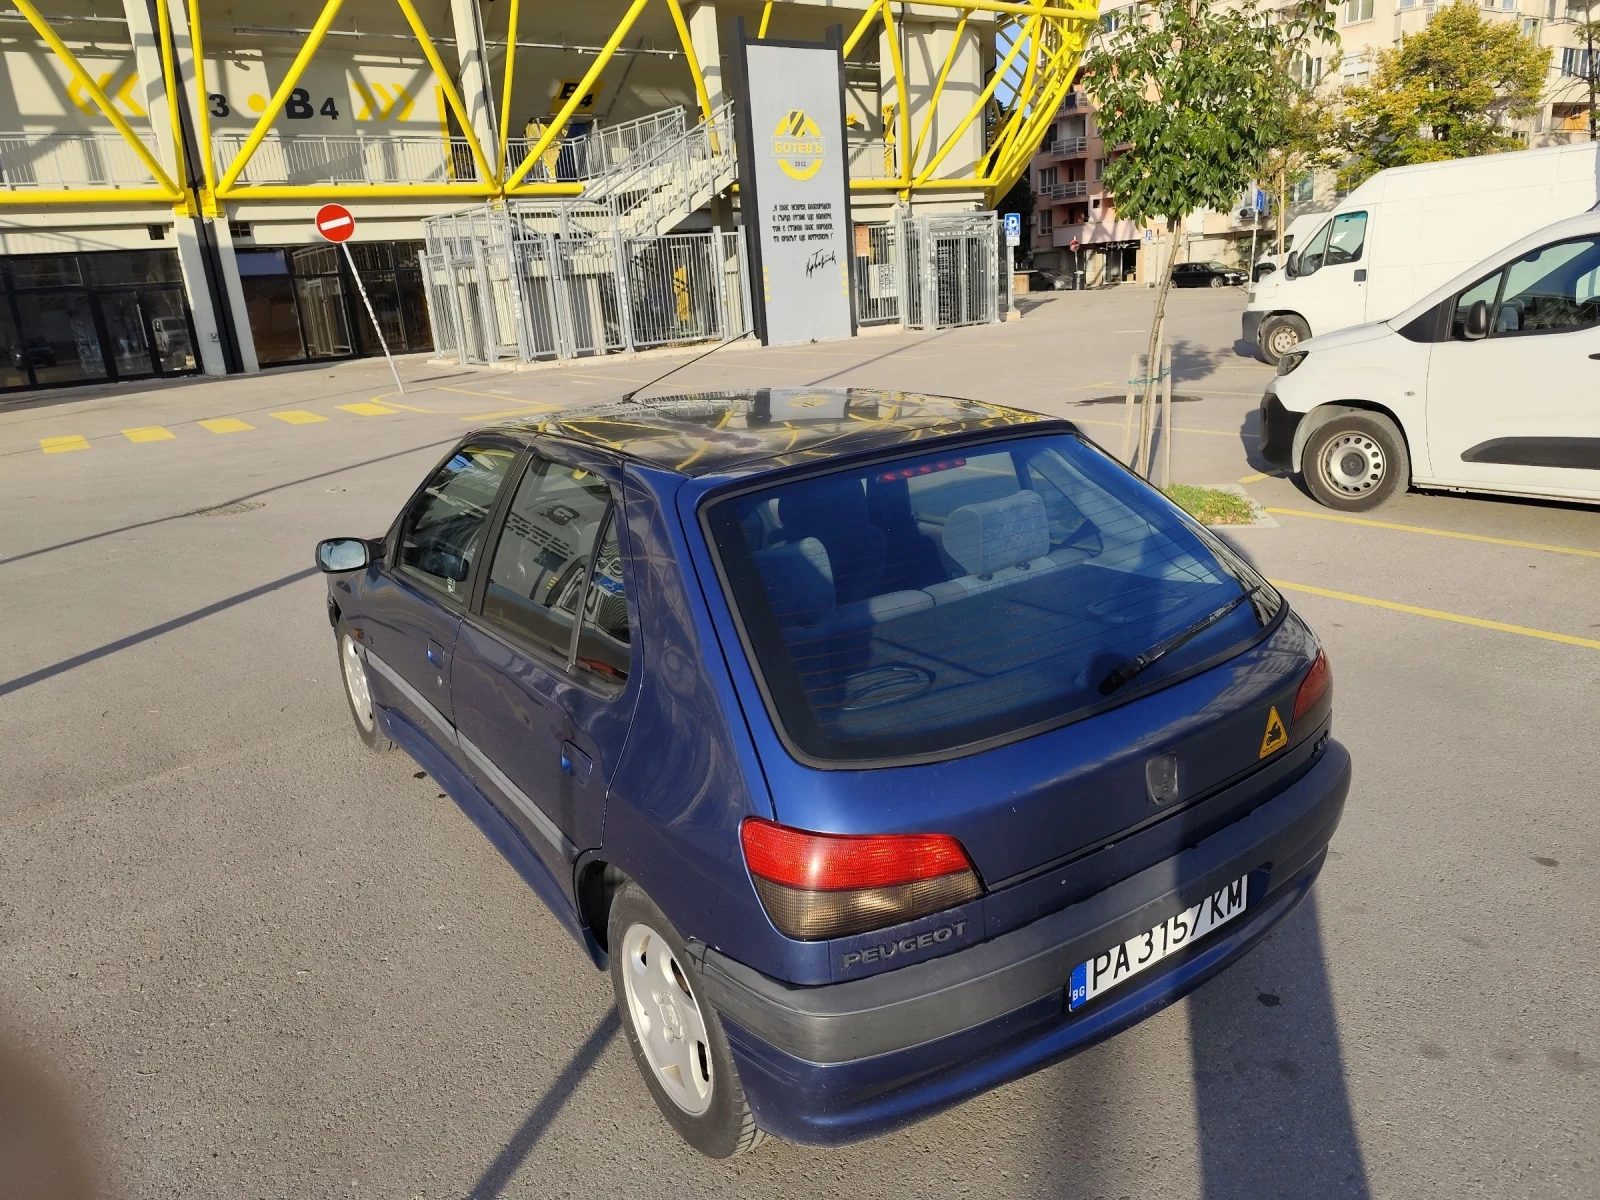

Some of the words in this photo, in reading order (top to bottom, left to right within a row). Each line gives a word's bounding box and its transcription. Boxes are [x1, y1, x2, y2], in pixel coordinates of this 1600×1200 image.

[775, 142, 822, 153] БОТЕВЪ
[841, 920, 967, 969] PEUGEOT
[1072, 986, 1085, 1001] BG
